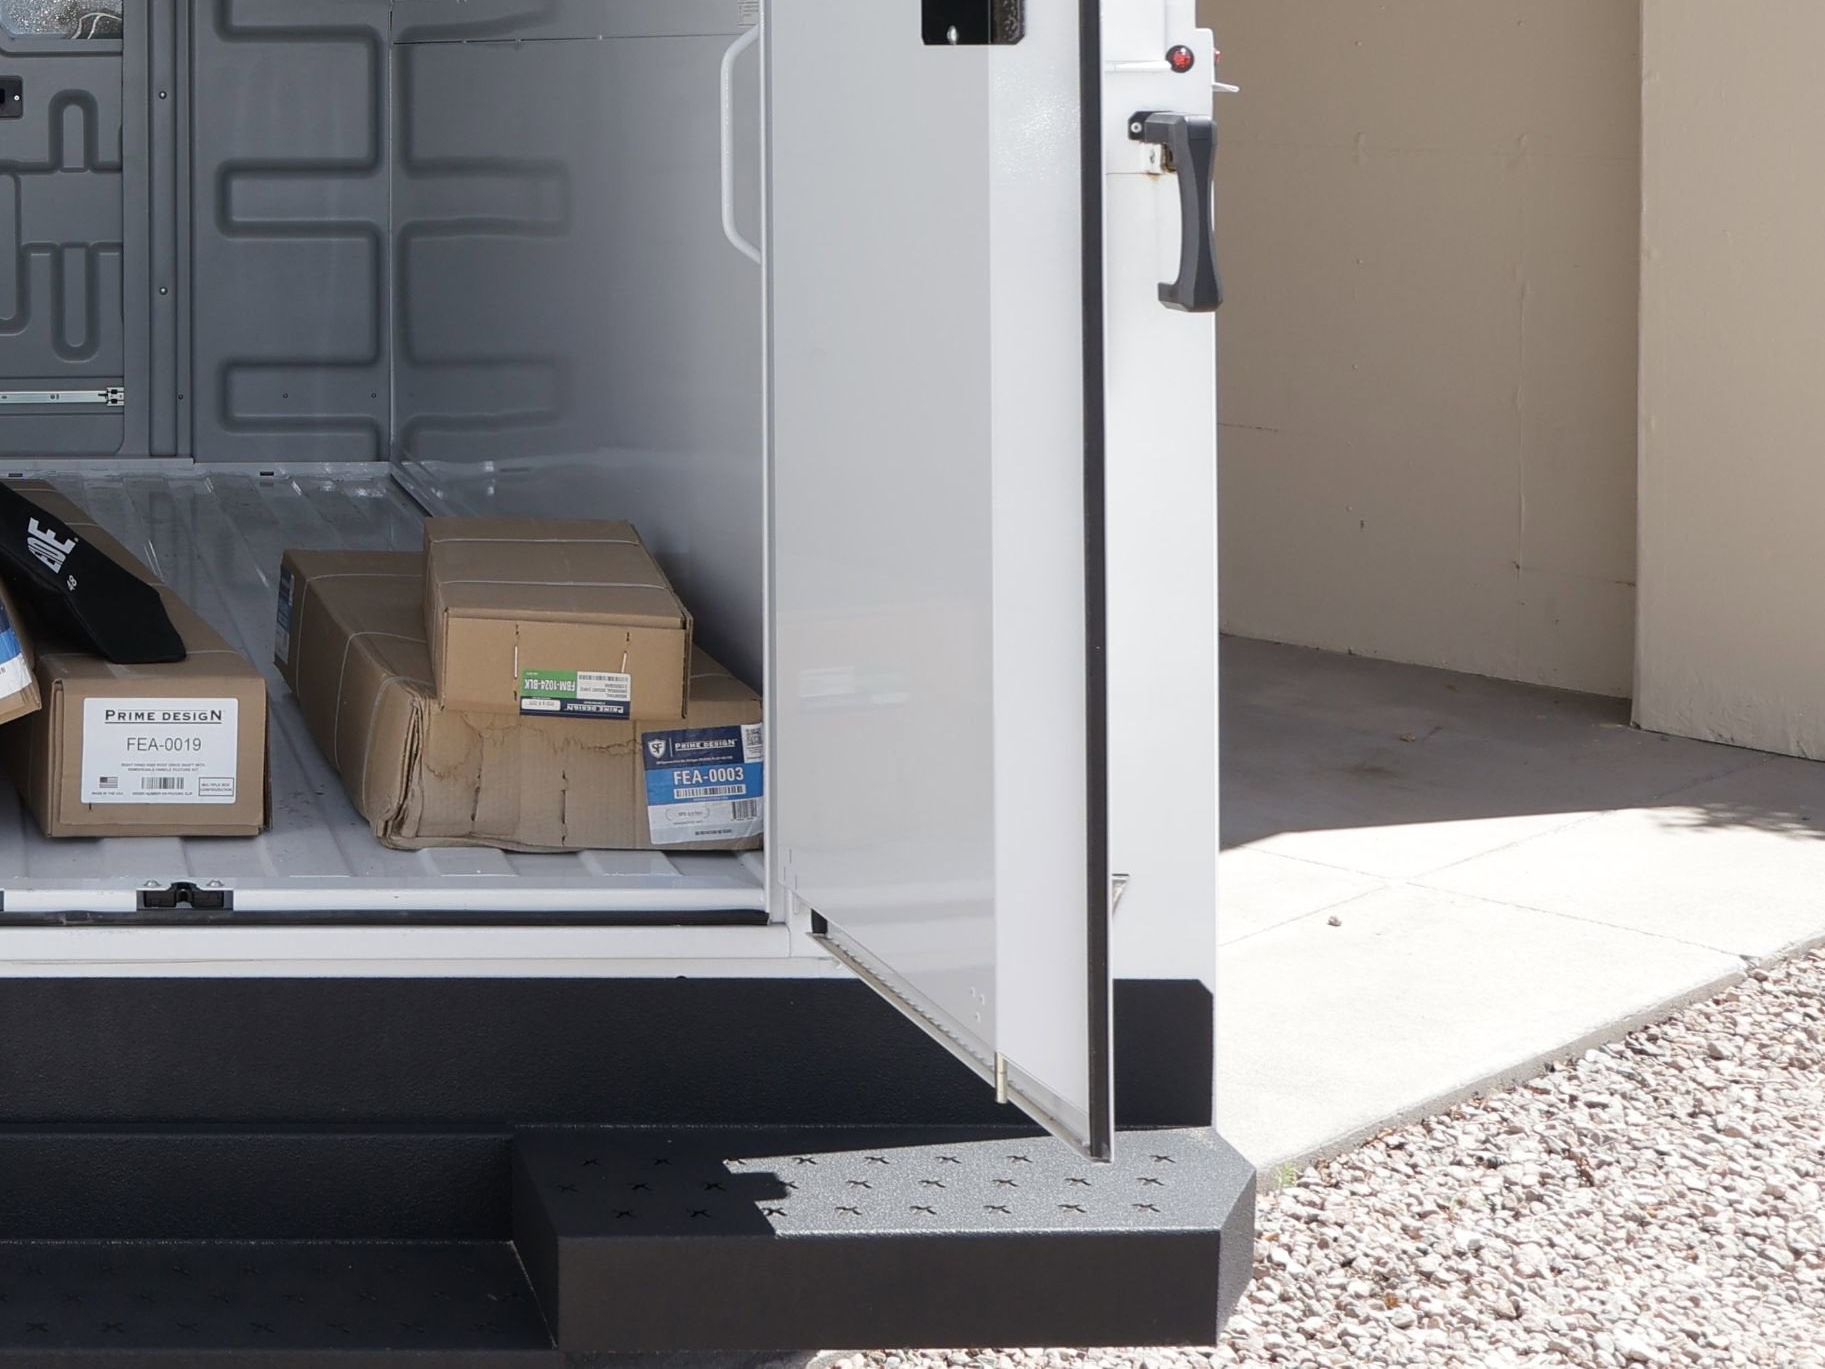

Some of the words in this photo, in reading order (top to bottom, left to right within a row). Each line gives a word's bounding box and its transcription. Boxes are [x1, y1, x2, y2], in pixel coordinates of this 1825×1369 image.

[524, 678, 576, 692] FBM-1024-BLK
[566, 703, 596, 712] DESIGN
[599, 705, 624, 714] PRIME
[105, 709, 156, 721] PRIME
[162, 709, 222, 721] DESIGN
[127, 737, 202, 751] FEA-0019
[675, 741, 701, 749] PRIME
[703, 739, 736, 748] DESIGN
[673, 766, 744, 785] FEA-0003
